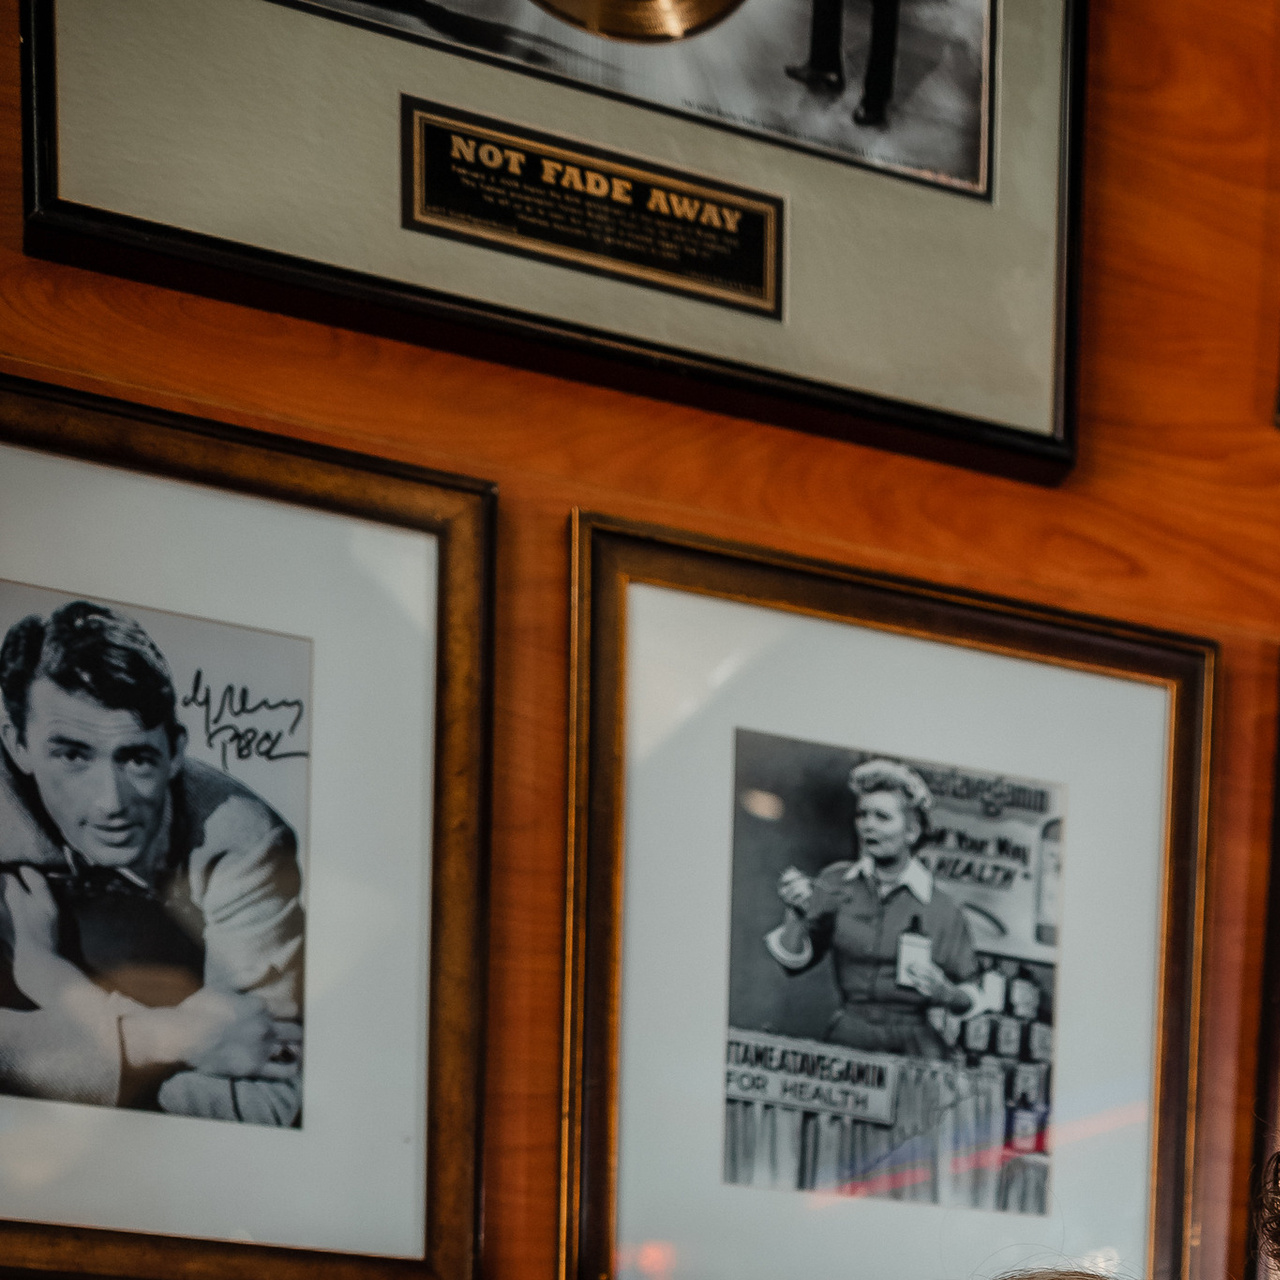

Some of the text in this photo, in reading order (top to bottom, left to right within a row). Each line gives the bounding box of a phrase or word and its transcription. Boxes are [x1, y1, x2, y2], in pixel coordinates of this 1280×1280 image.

[450, 134, 526, 176] NOT
[541, 157, 634, 205] FADE
[646, 187, 744, 234] AWAY
[780, 1078, 870, 1111] HEALTH
